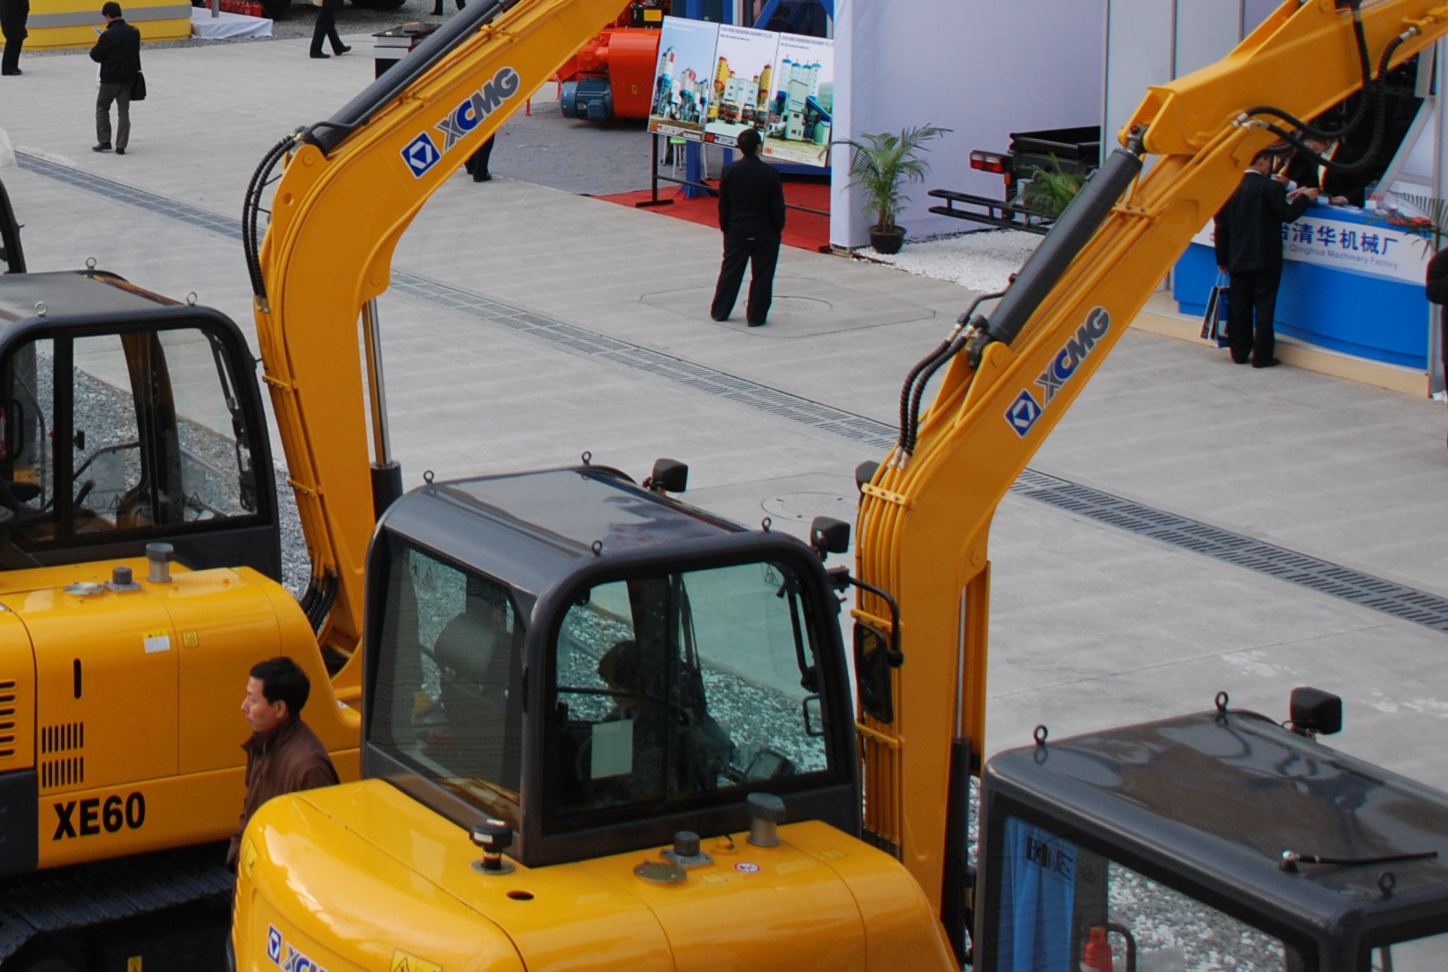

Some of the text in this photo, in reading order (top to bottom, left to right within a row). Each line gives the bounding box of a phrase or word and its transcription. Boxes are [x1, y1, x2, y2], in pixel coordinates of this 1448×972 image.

[434, 67, 520, 154] XCMG
[1327, 249, 1369, 263] Machinery
[1370, 256, 1398, 270] Factory
[1033, 305, 1111, 409] XCMG
[52, 791, 147, 841] XE60
